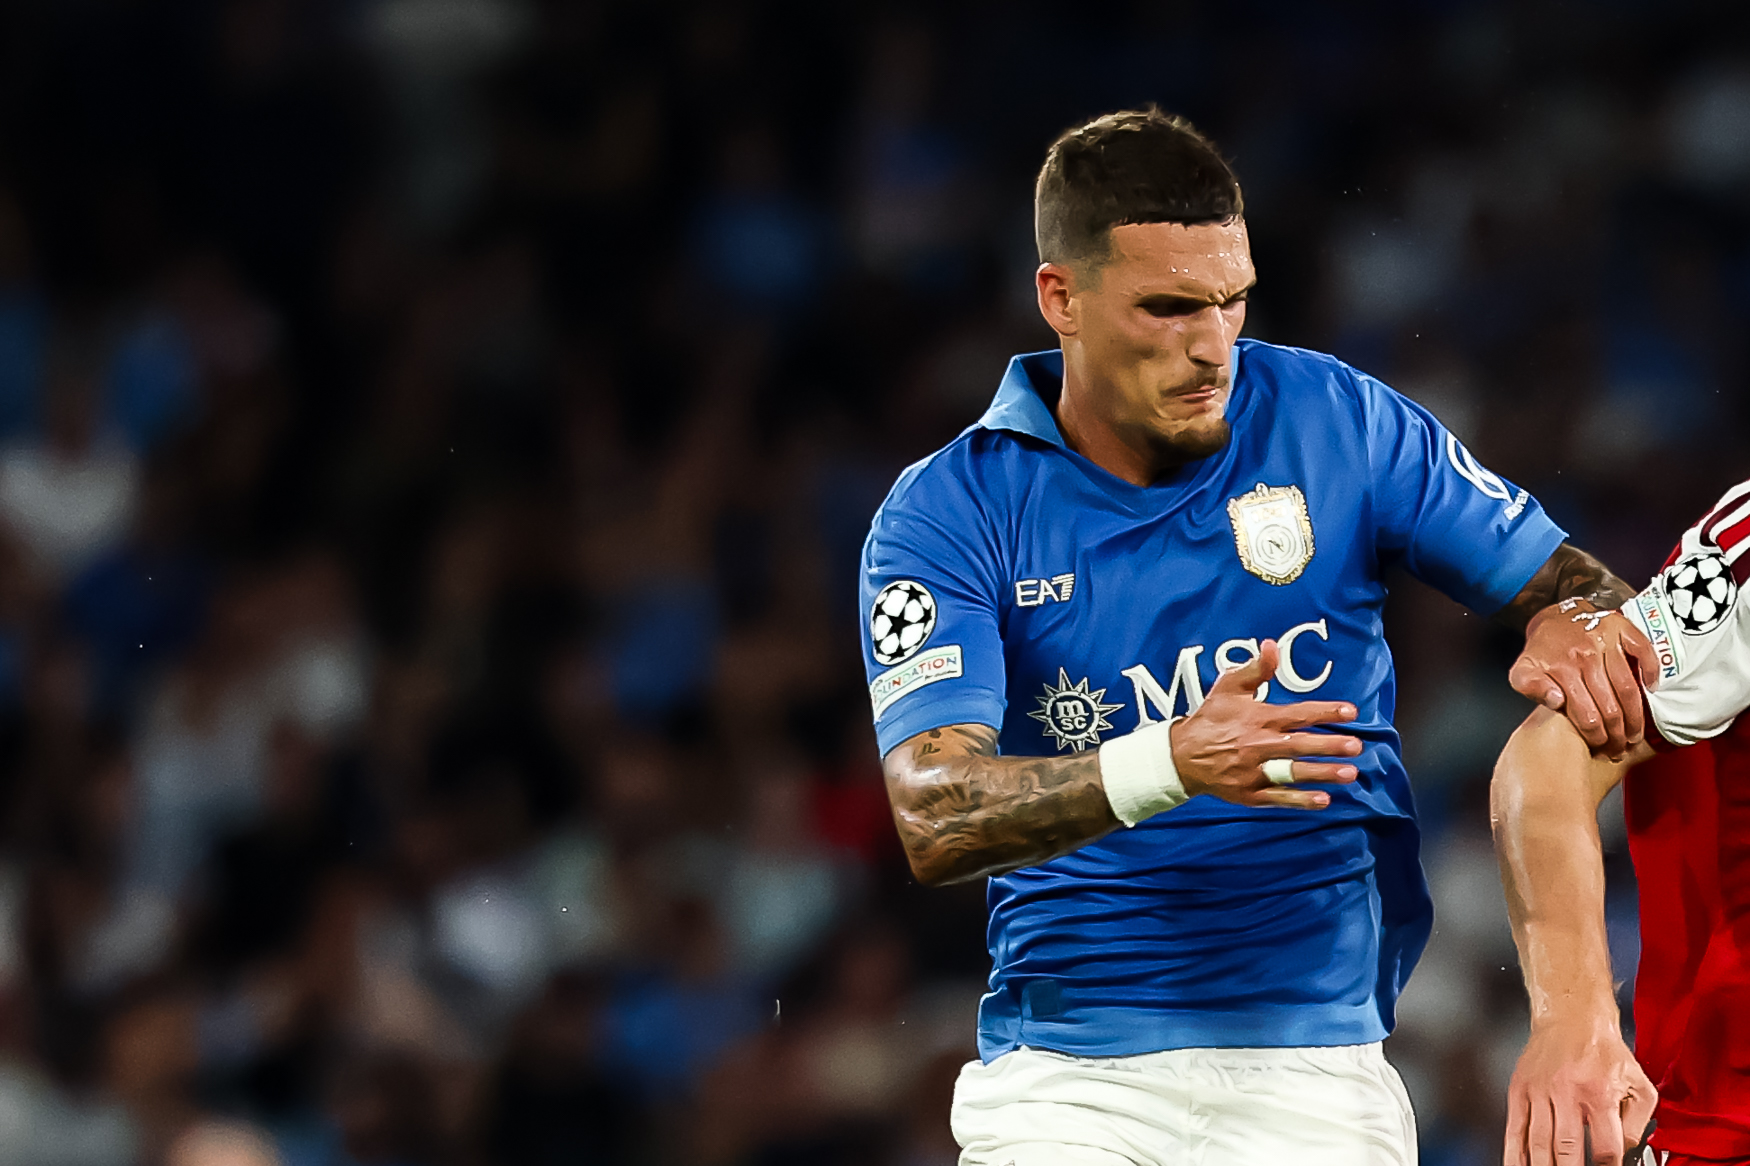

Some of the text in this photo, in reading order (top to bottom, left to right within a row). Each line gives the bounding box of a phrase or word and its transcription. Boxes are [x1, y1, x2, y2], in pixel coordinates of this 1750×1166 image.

[1015, 573, 1074, 607] EA7
[1121, 618, 1333, 732] MSC
[1641, 591, 1677, 679] FOUNDATION
